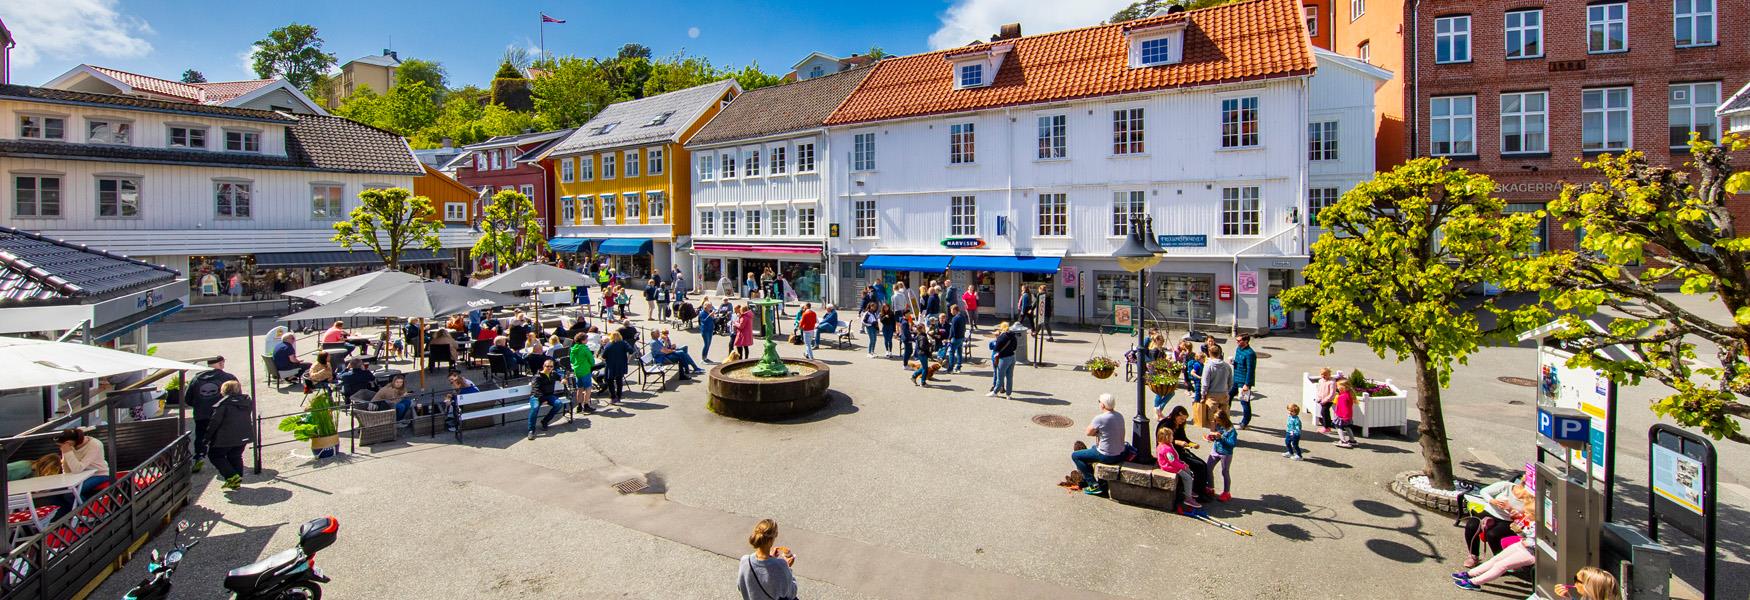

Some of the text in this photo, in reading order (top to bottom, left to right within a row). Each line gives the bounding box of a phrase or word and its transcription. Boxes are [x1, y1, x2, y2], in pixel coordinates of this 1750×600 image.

[1494, 181, 1563, 193] SKAGERRA
[1541, 412, 1550, 431] P
[1561, 419, 1582, 438] P
